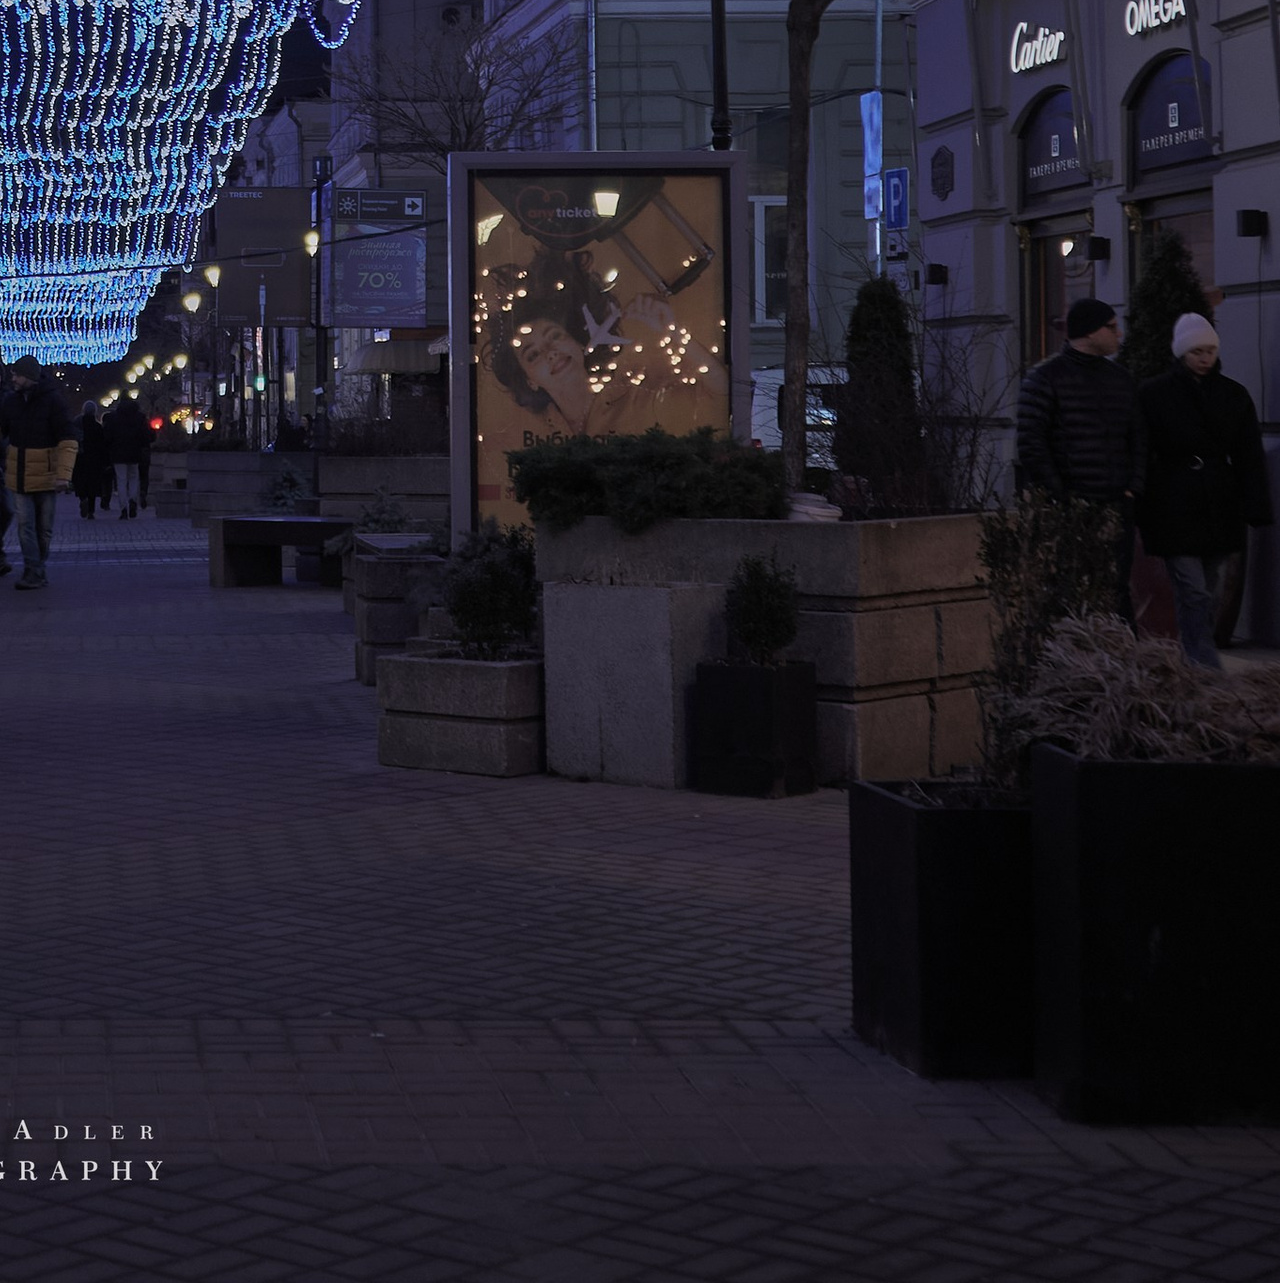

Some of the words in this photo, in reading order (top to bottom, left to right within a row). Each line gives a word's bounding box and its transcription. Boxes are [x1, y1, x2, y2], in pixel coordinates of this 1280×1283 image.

[1010, 22, 1065, 73] Cartier
[229, 191, 263, 199] TREETEC
[358, 272, 402, 288] 70%
